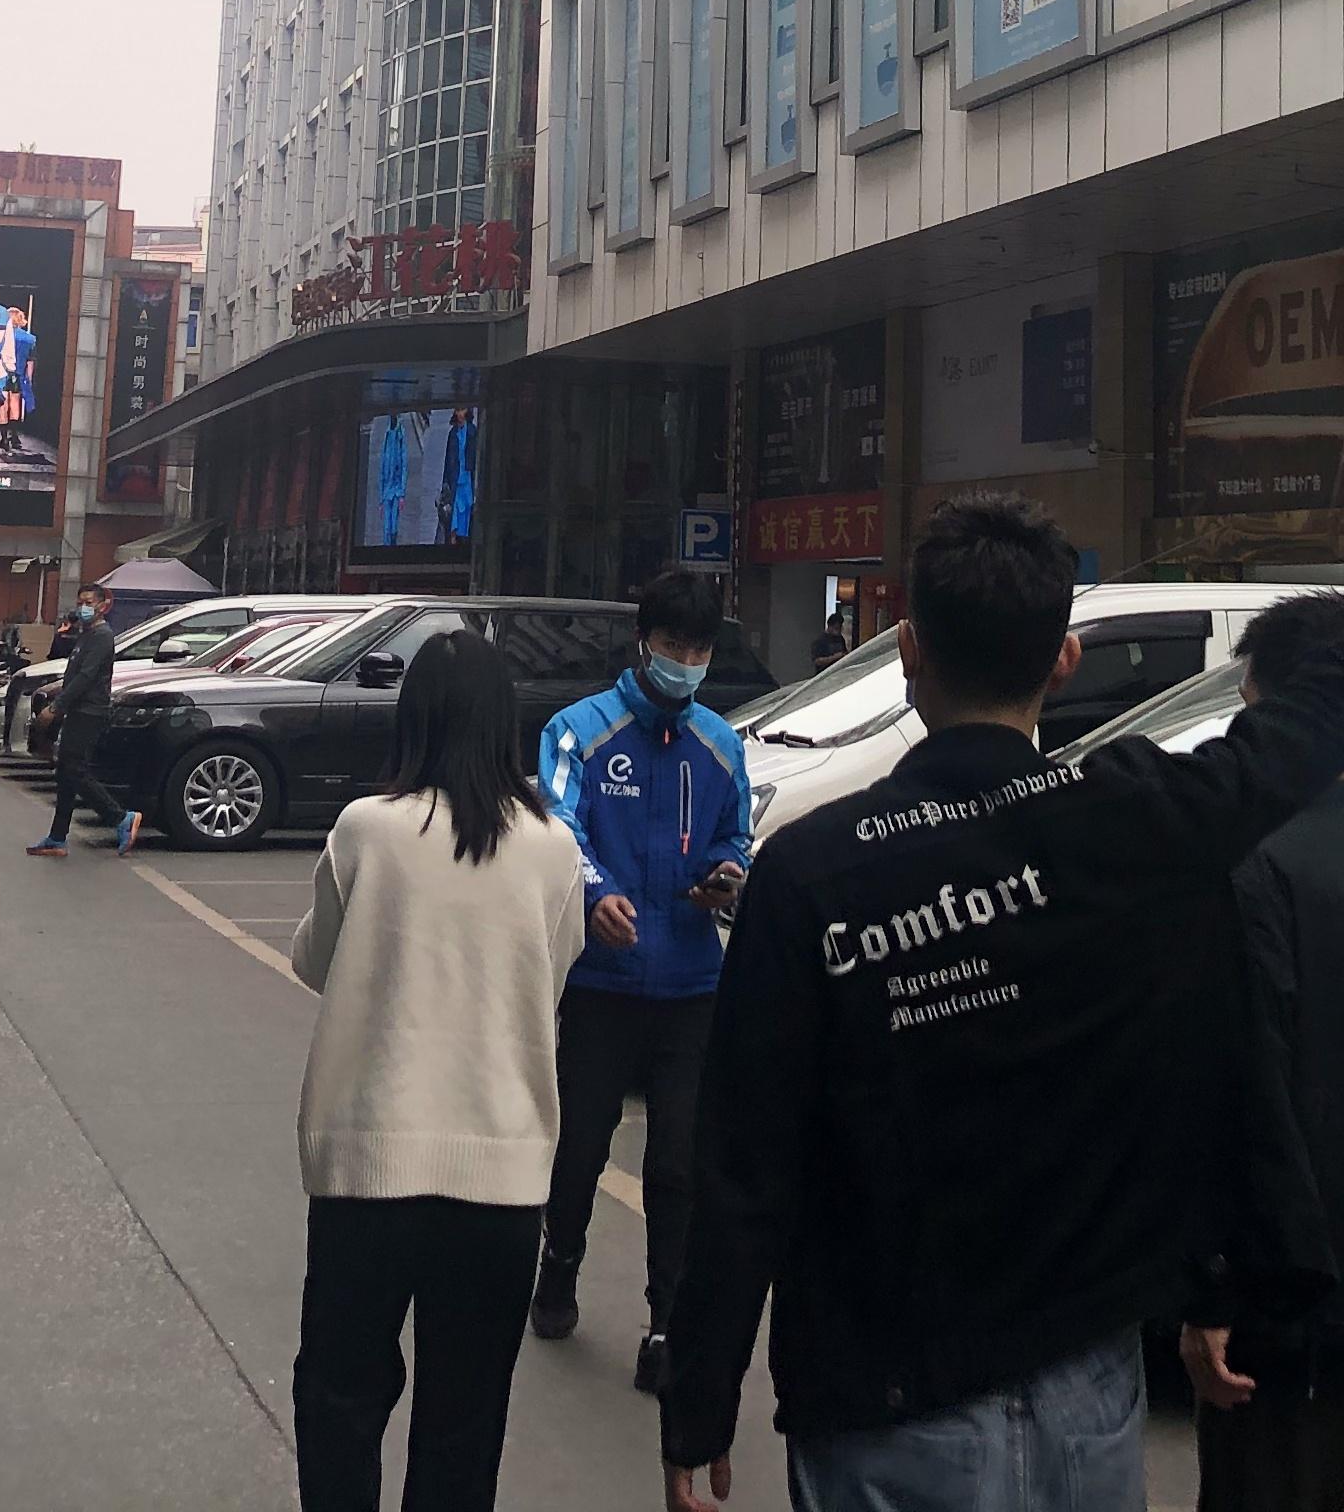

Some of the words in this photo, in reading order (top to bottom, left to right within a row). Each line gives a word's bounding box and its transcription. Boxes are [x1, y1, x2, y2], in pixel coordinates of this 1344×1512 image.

[130, 334, 149, 423] 时尚男装
[685, 514, 719, 558] P
[759, 504, 880, 552] 诚信赢天下
[822, 863, 1049, 977] Comfort
[887, 954, 990, 999] Agreeable
[891, 982, 1021, 1033] Manufacture
